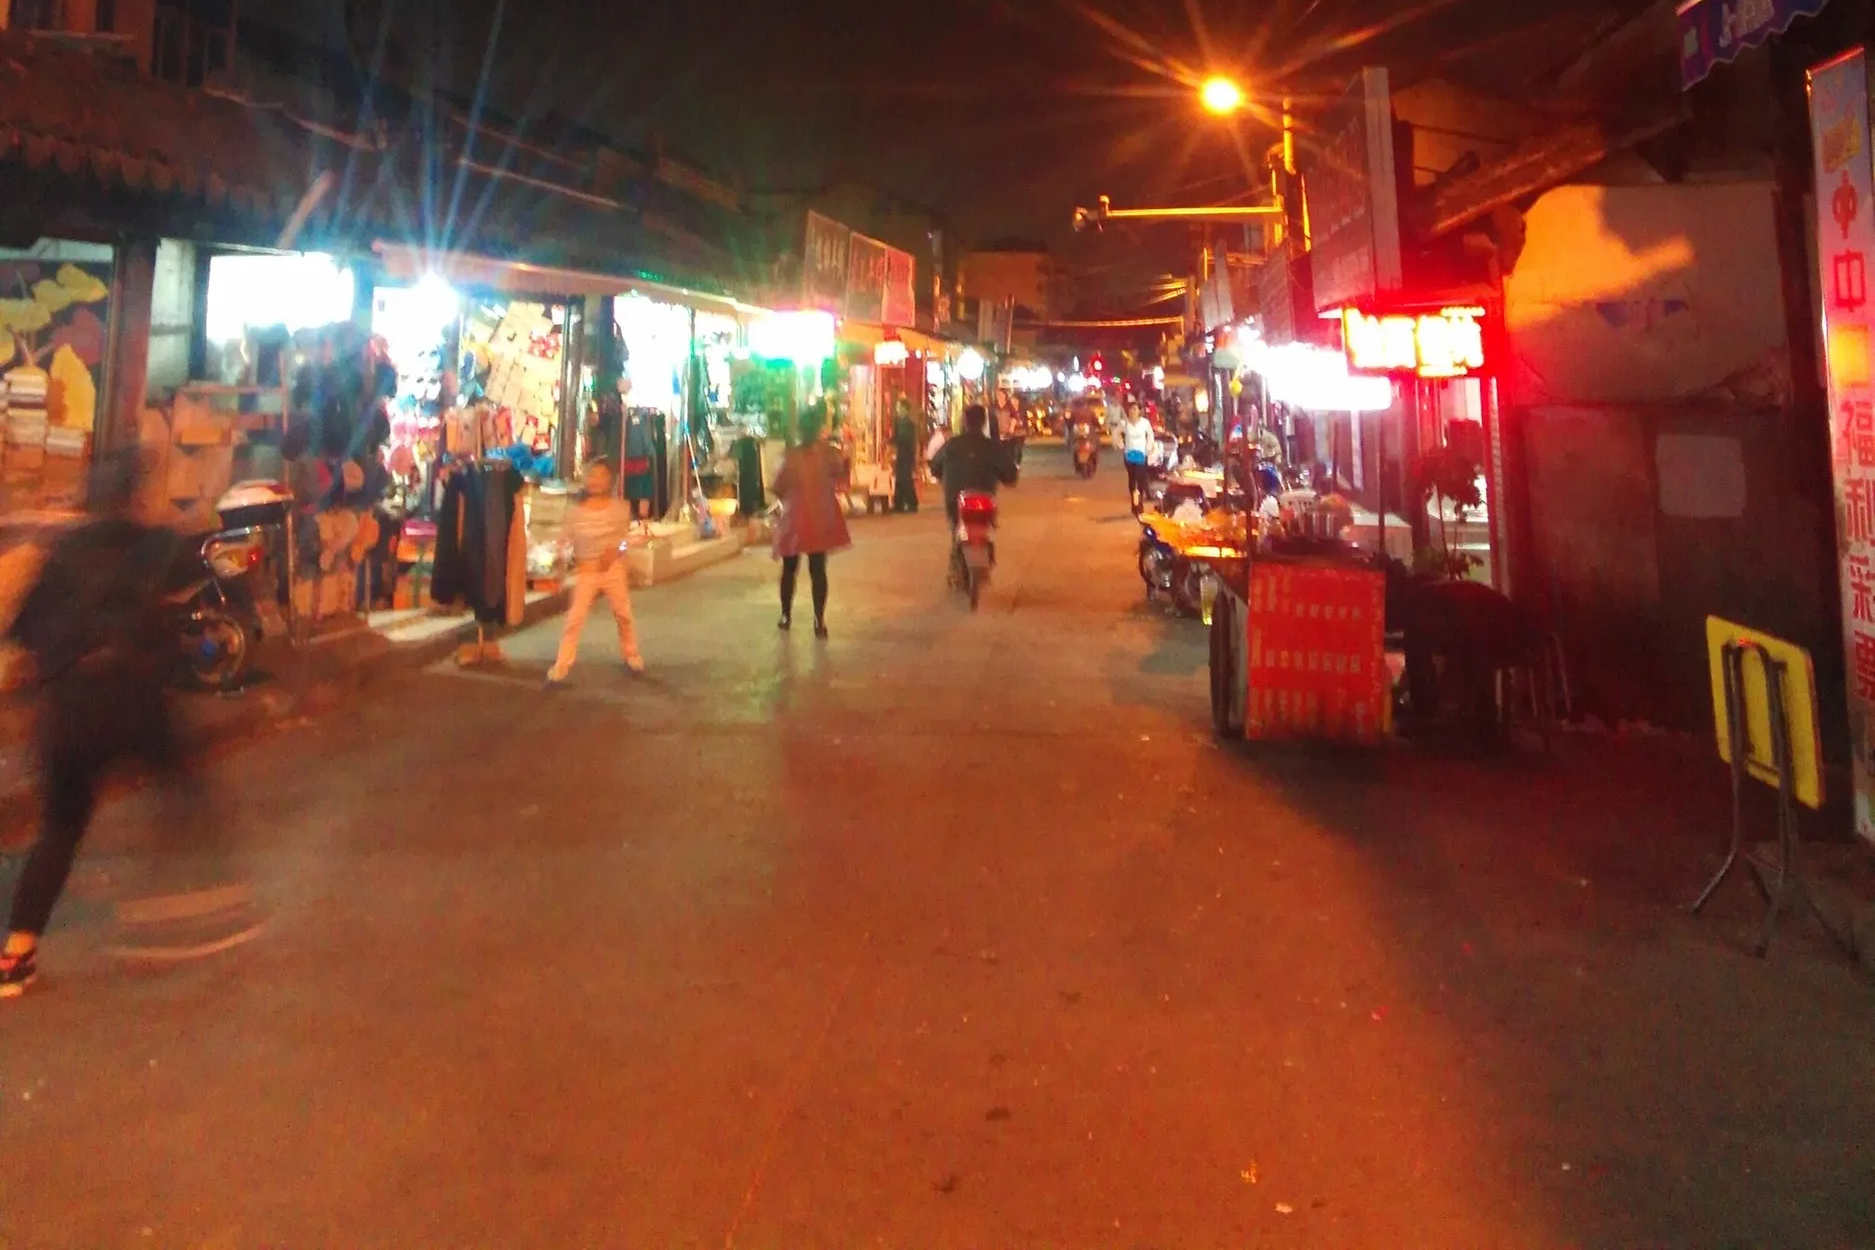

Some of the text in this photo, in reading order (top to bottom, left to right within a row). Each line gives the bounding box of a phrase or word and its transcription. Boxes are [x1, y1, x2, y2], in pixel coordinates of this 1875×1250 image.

[1833, 248, 1875, 700] 中福利彩票
